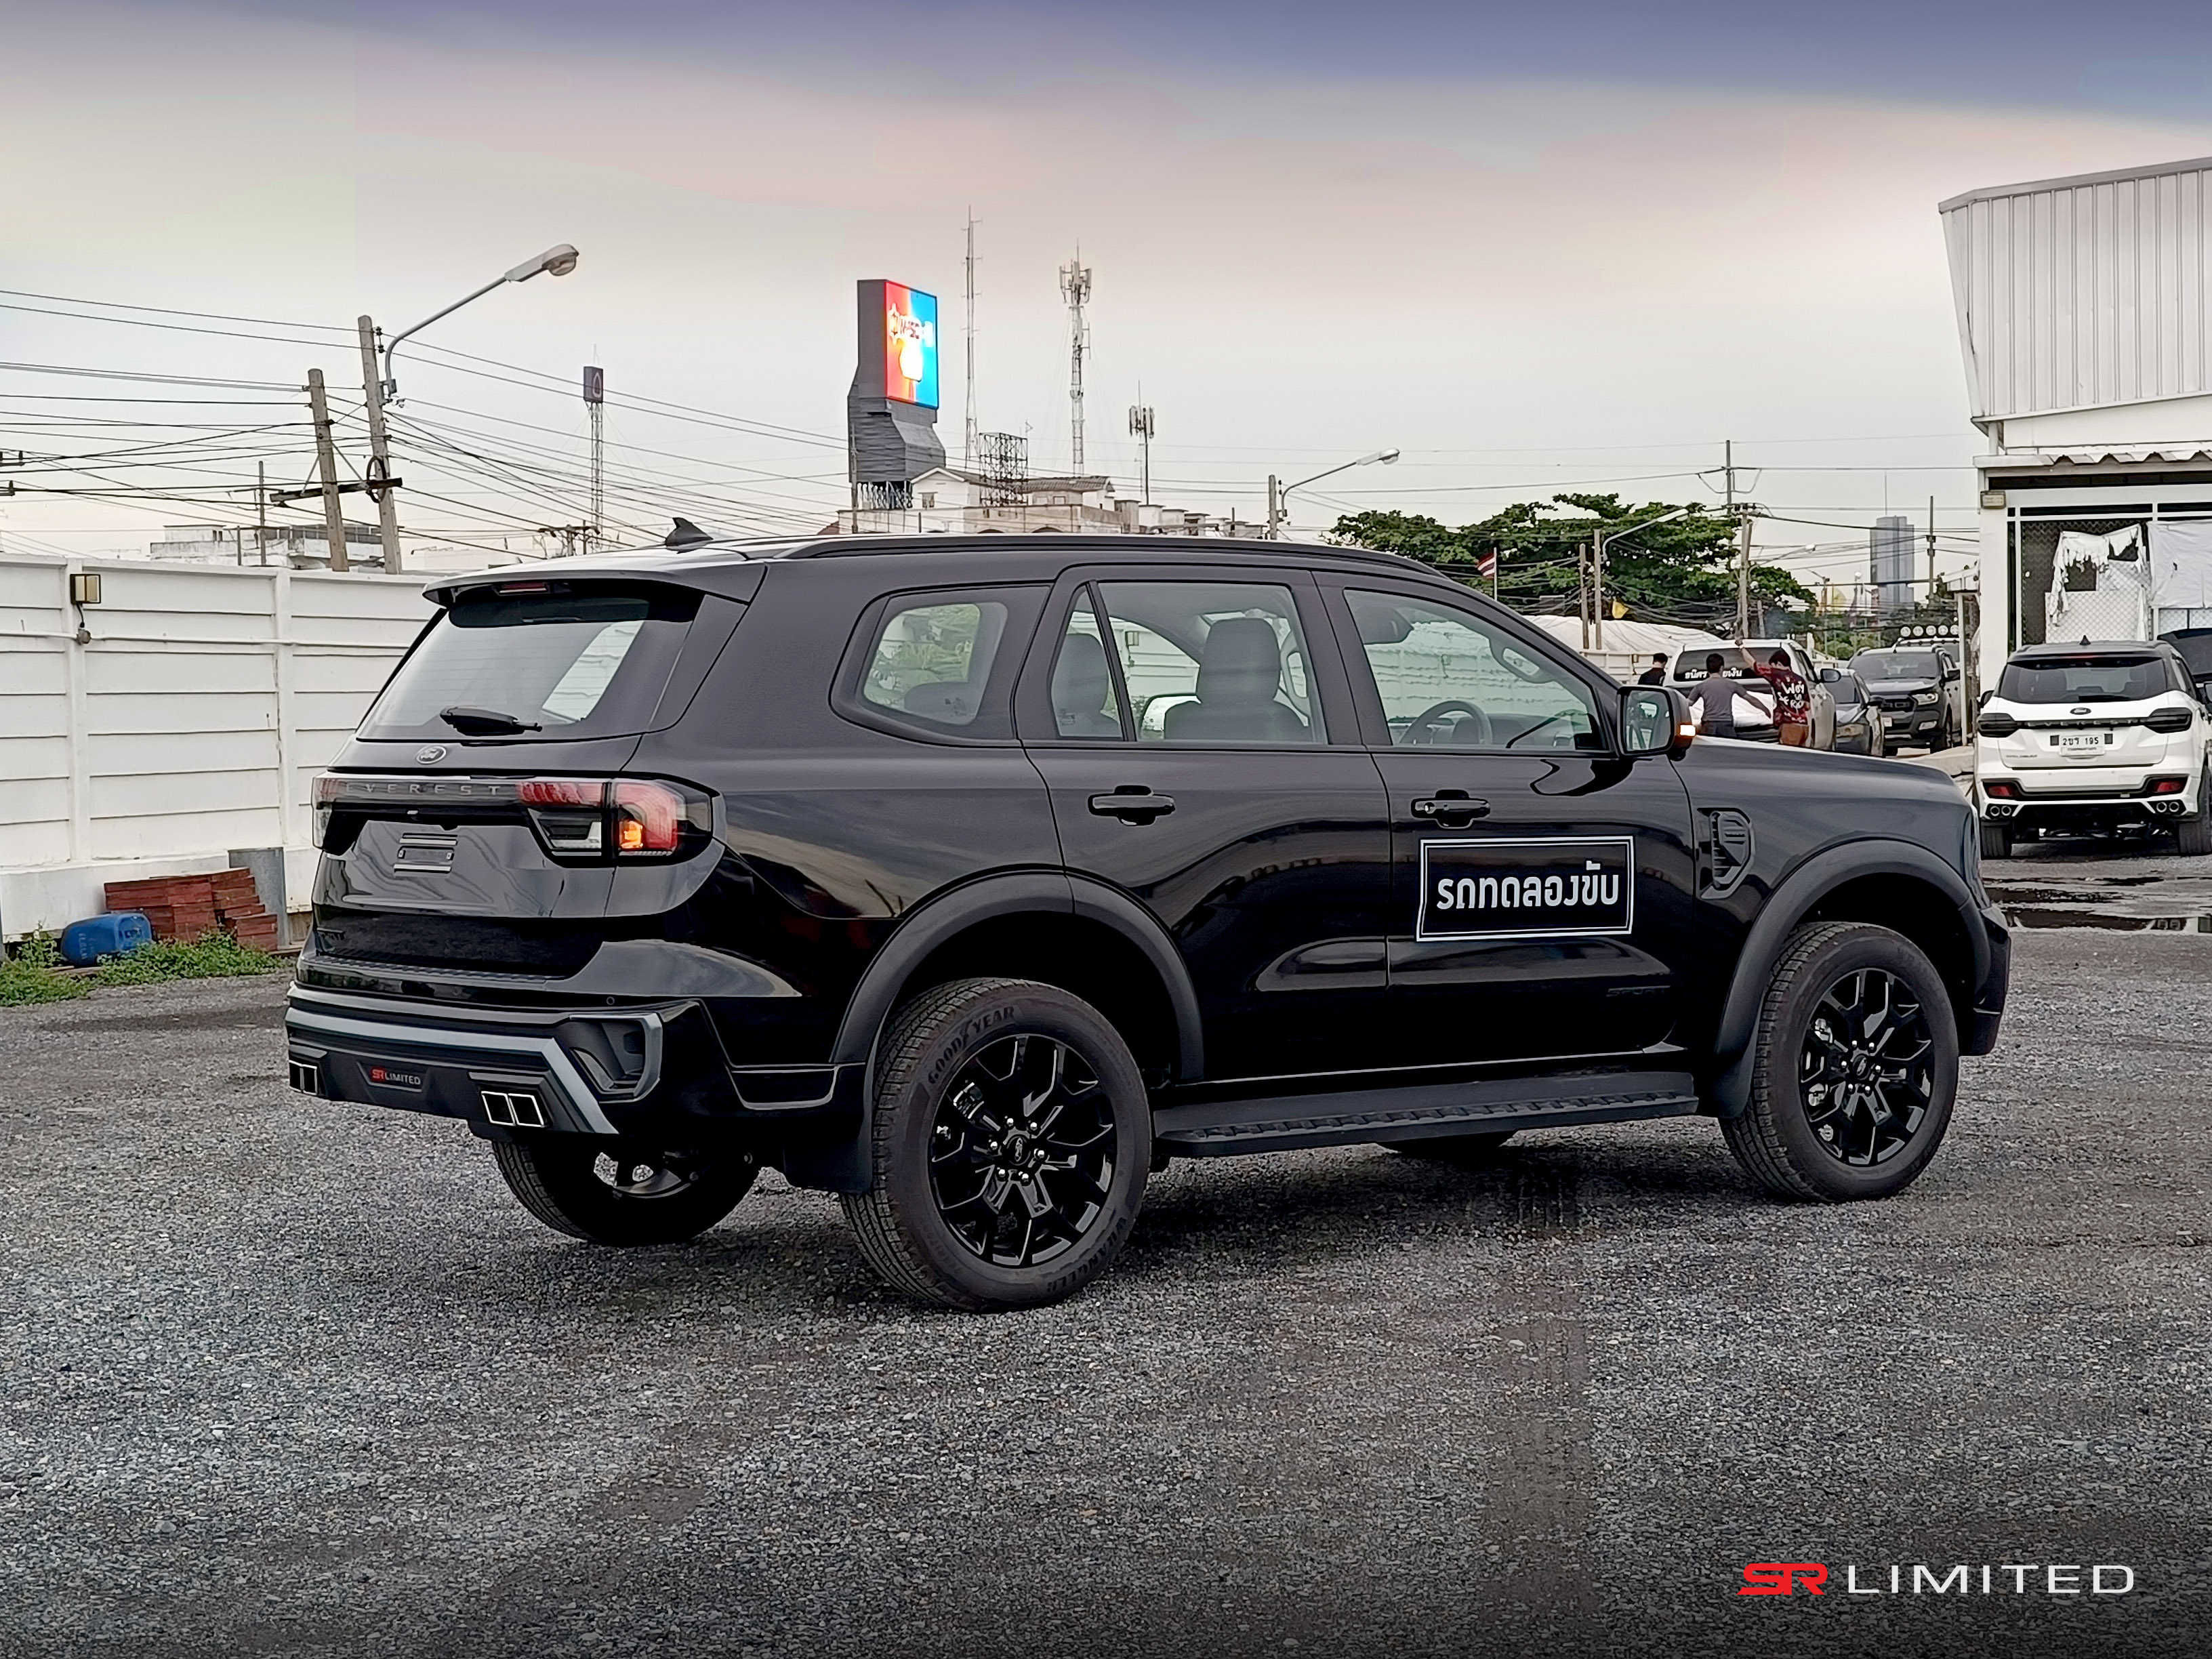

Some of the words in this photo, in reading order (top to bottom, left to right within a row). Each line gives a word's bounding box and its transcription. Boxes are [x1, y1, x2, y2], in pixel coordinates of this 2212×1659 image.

[2085, 737, 2100, 745] 195
[346, 783, 501, 796] EVEREST
[1436, 860, 1619, 910] รถทดลองขับ
[372, 1069, 385, 1080] SR
[384, 1072, 421, 1085] LIMITED
